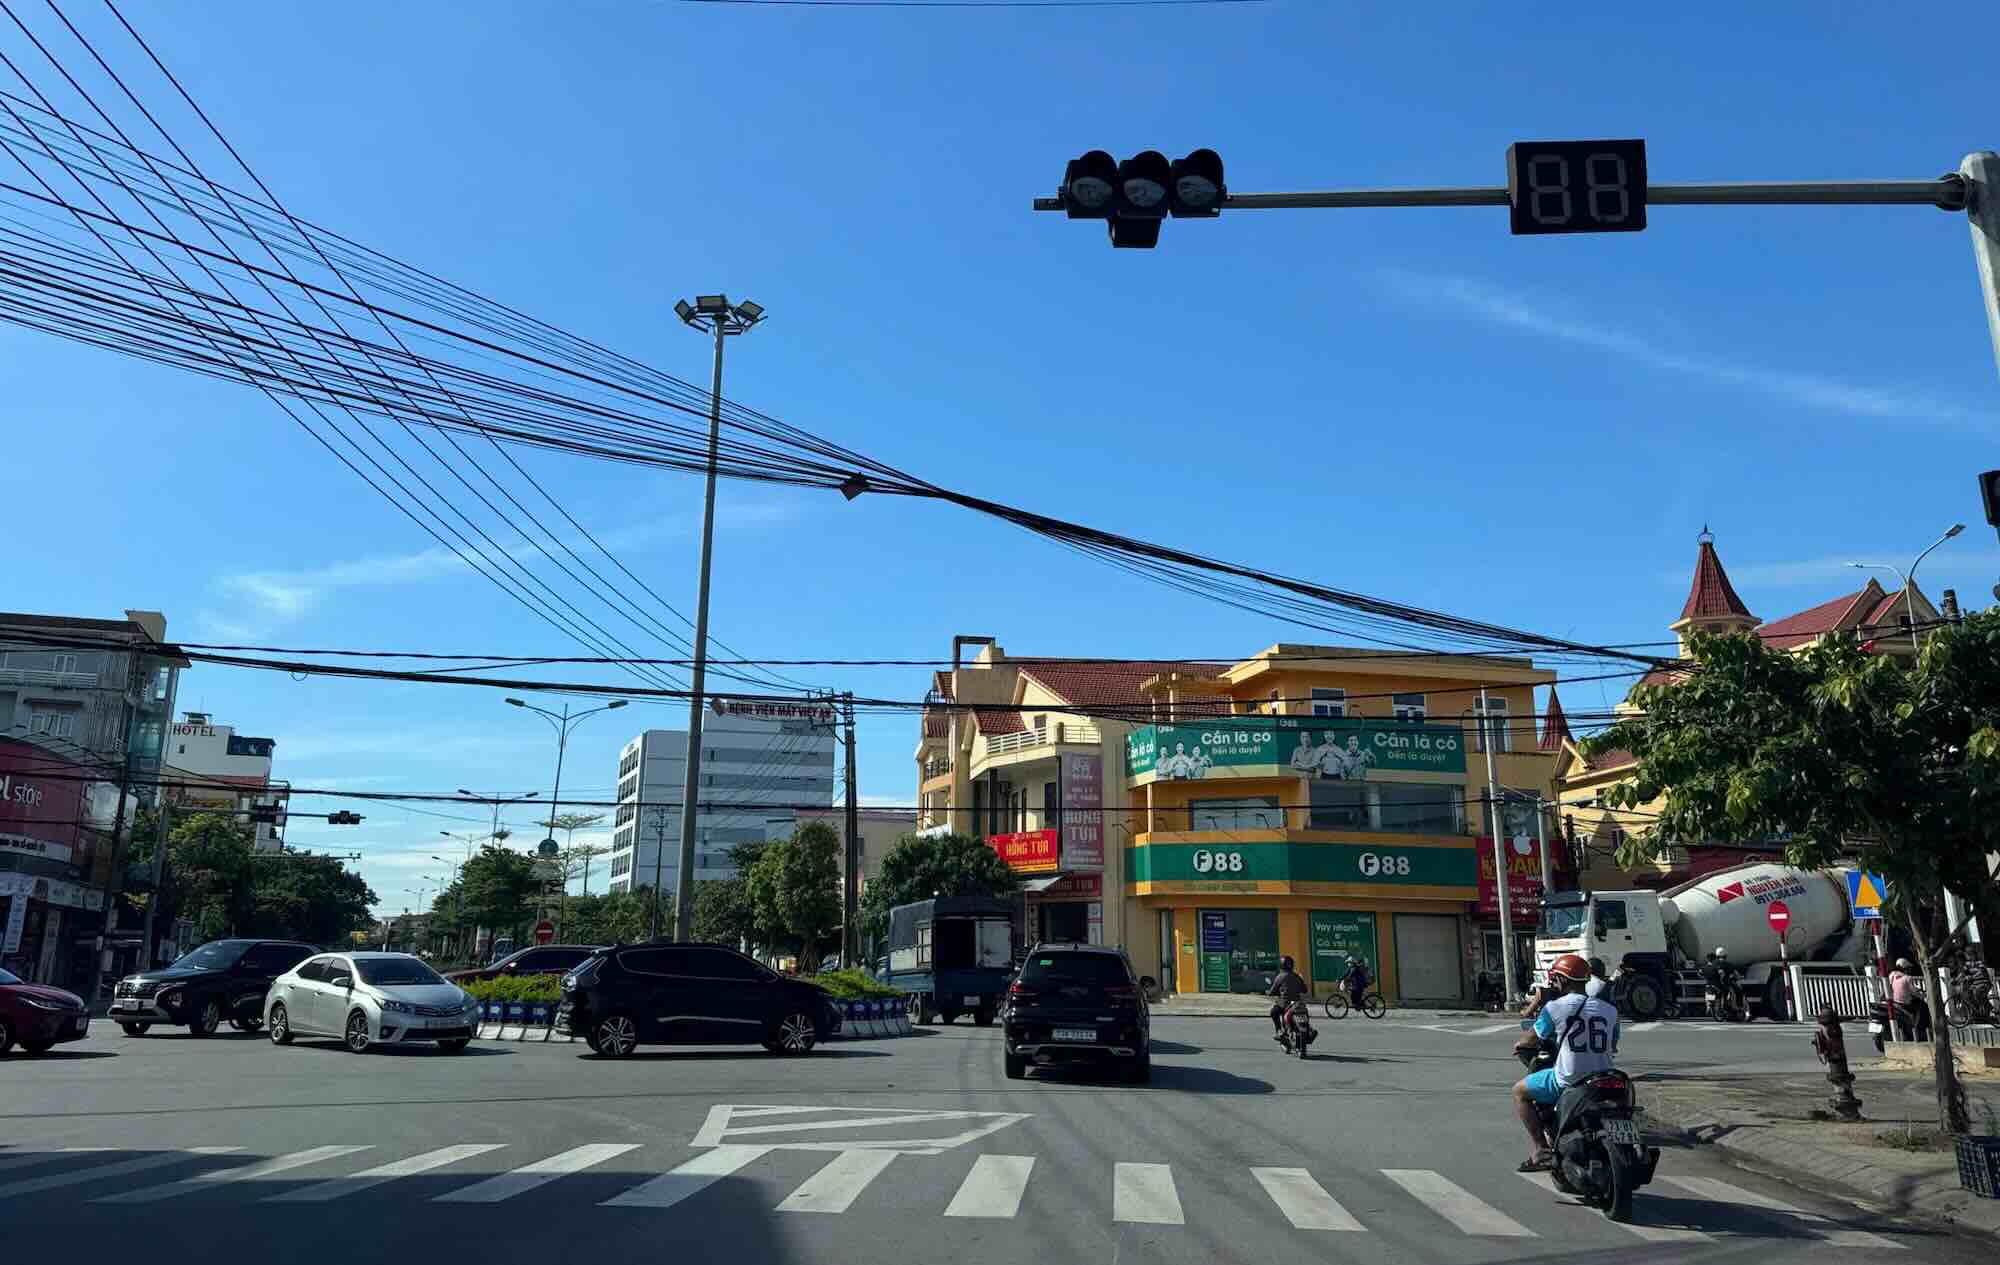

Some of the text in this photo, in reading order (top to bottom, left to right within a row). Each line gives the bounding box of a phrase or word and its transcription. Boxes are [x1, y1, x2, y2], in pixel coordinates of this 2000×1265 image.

[173, 725, 216, 737] HOTEL
[14, 784, 42, 807] store
[1566, 1016, 1608, 1053] 26
